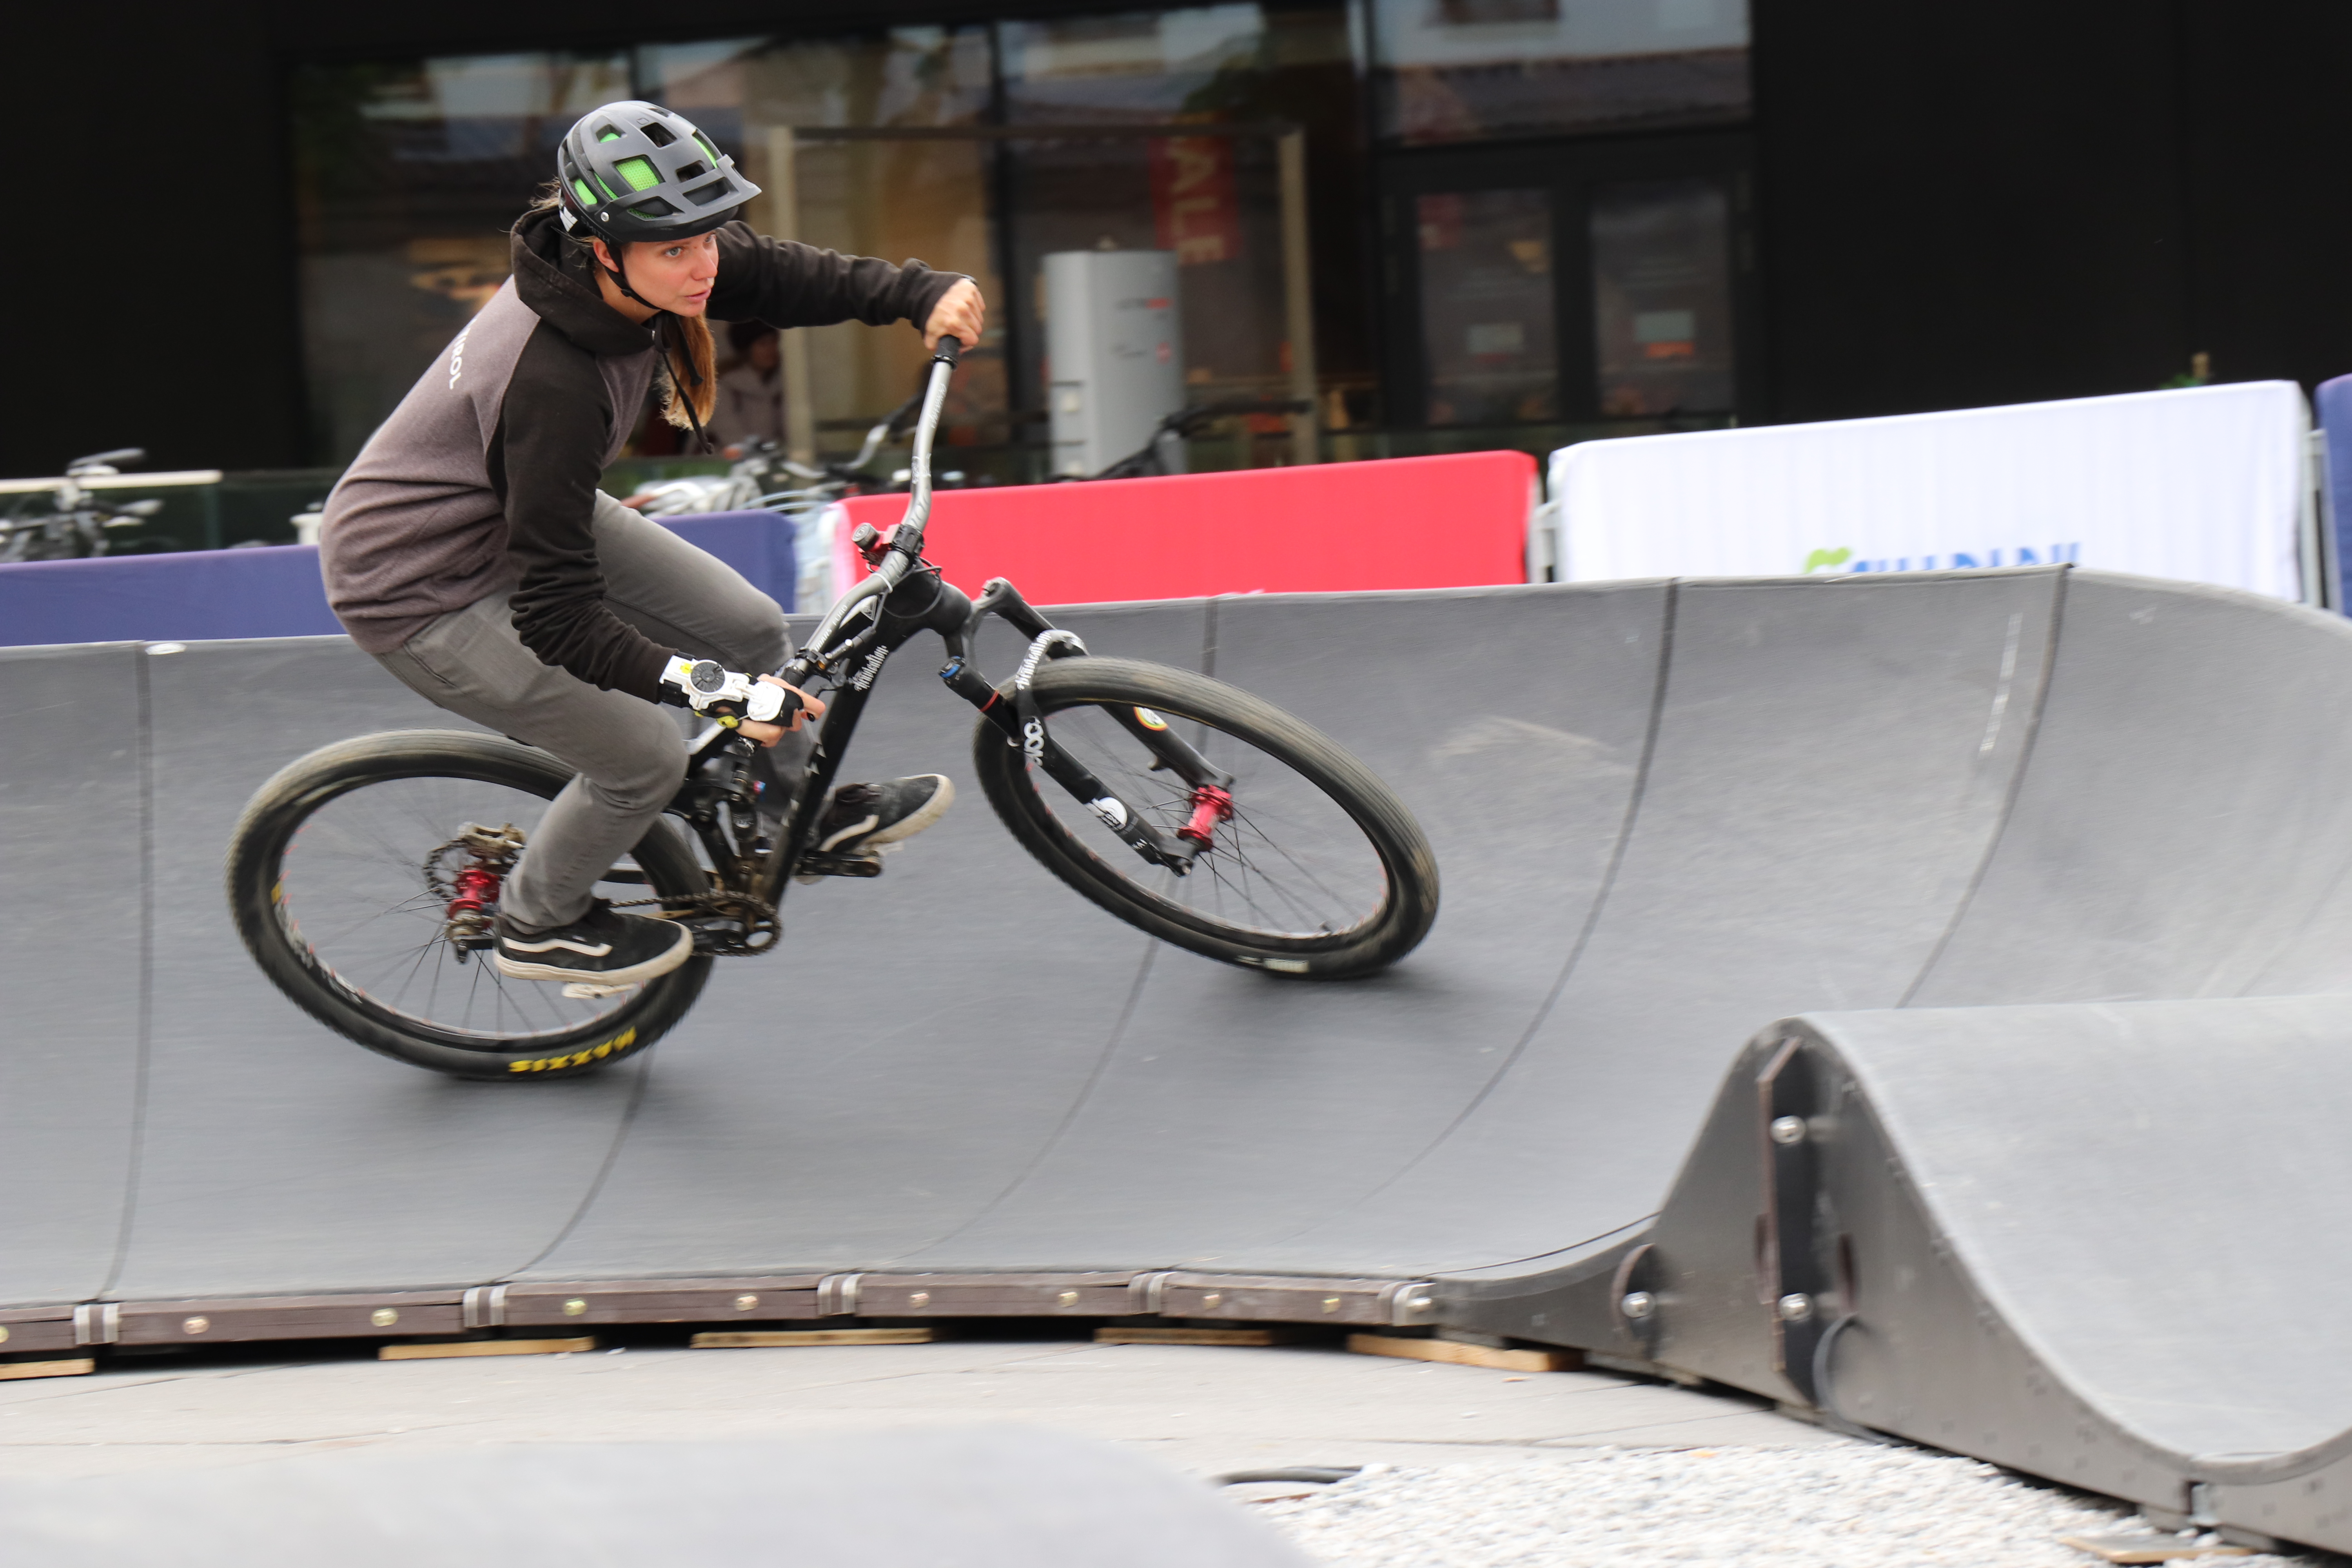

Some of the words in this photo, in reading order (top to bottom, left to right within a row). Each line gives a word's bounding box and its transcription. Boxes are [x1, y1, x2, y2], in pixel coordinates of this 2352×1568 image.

[1164, 129, 1225, 265] ALE
[581, 215, 610, 245] SMITH
[508, 1025, 637, 1073] MAXXIS
